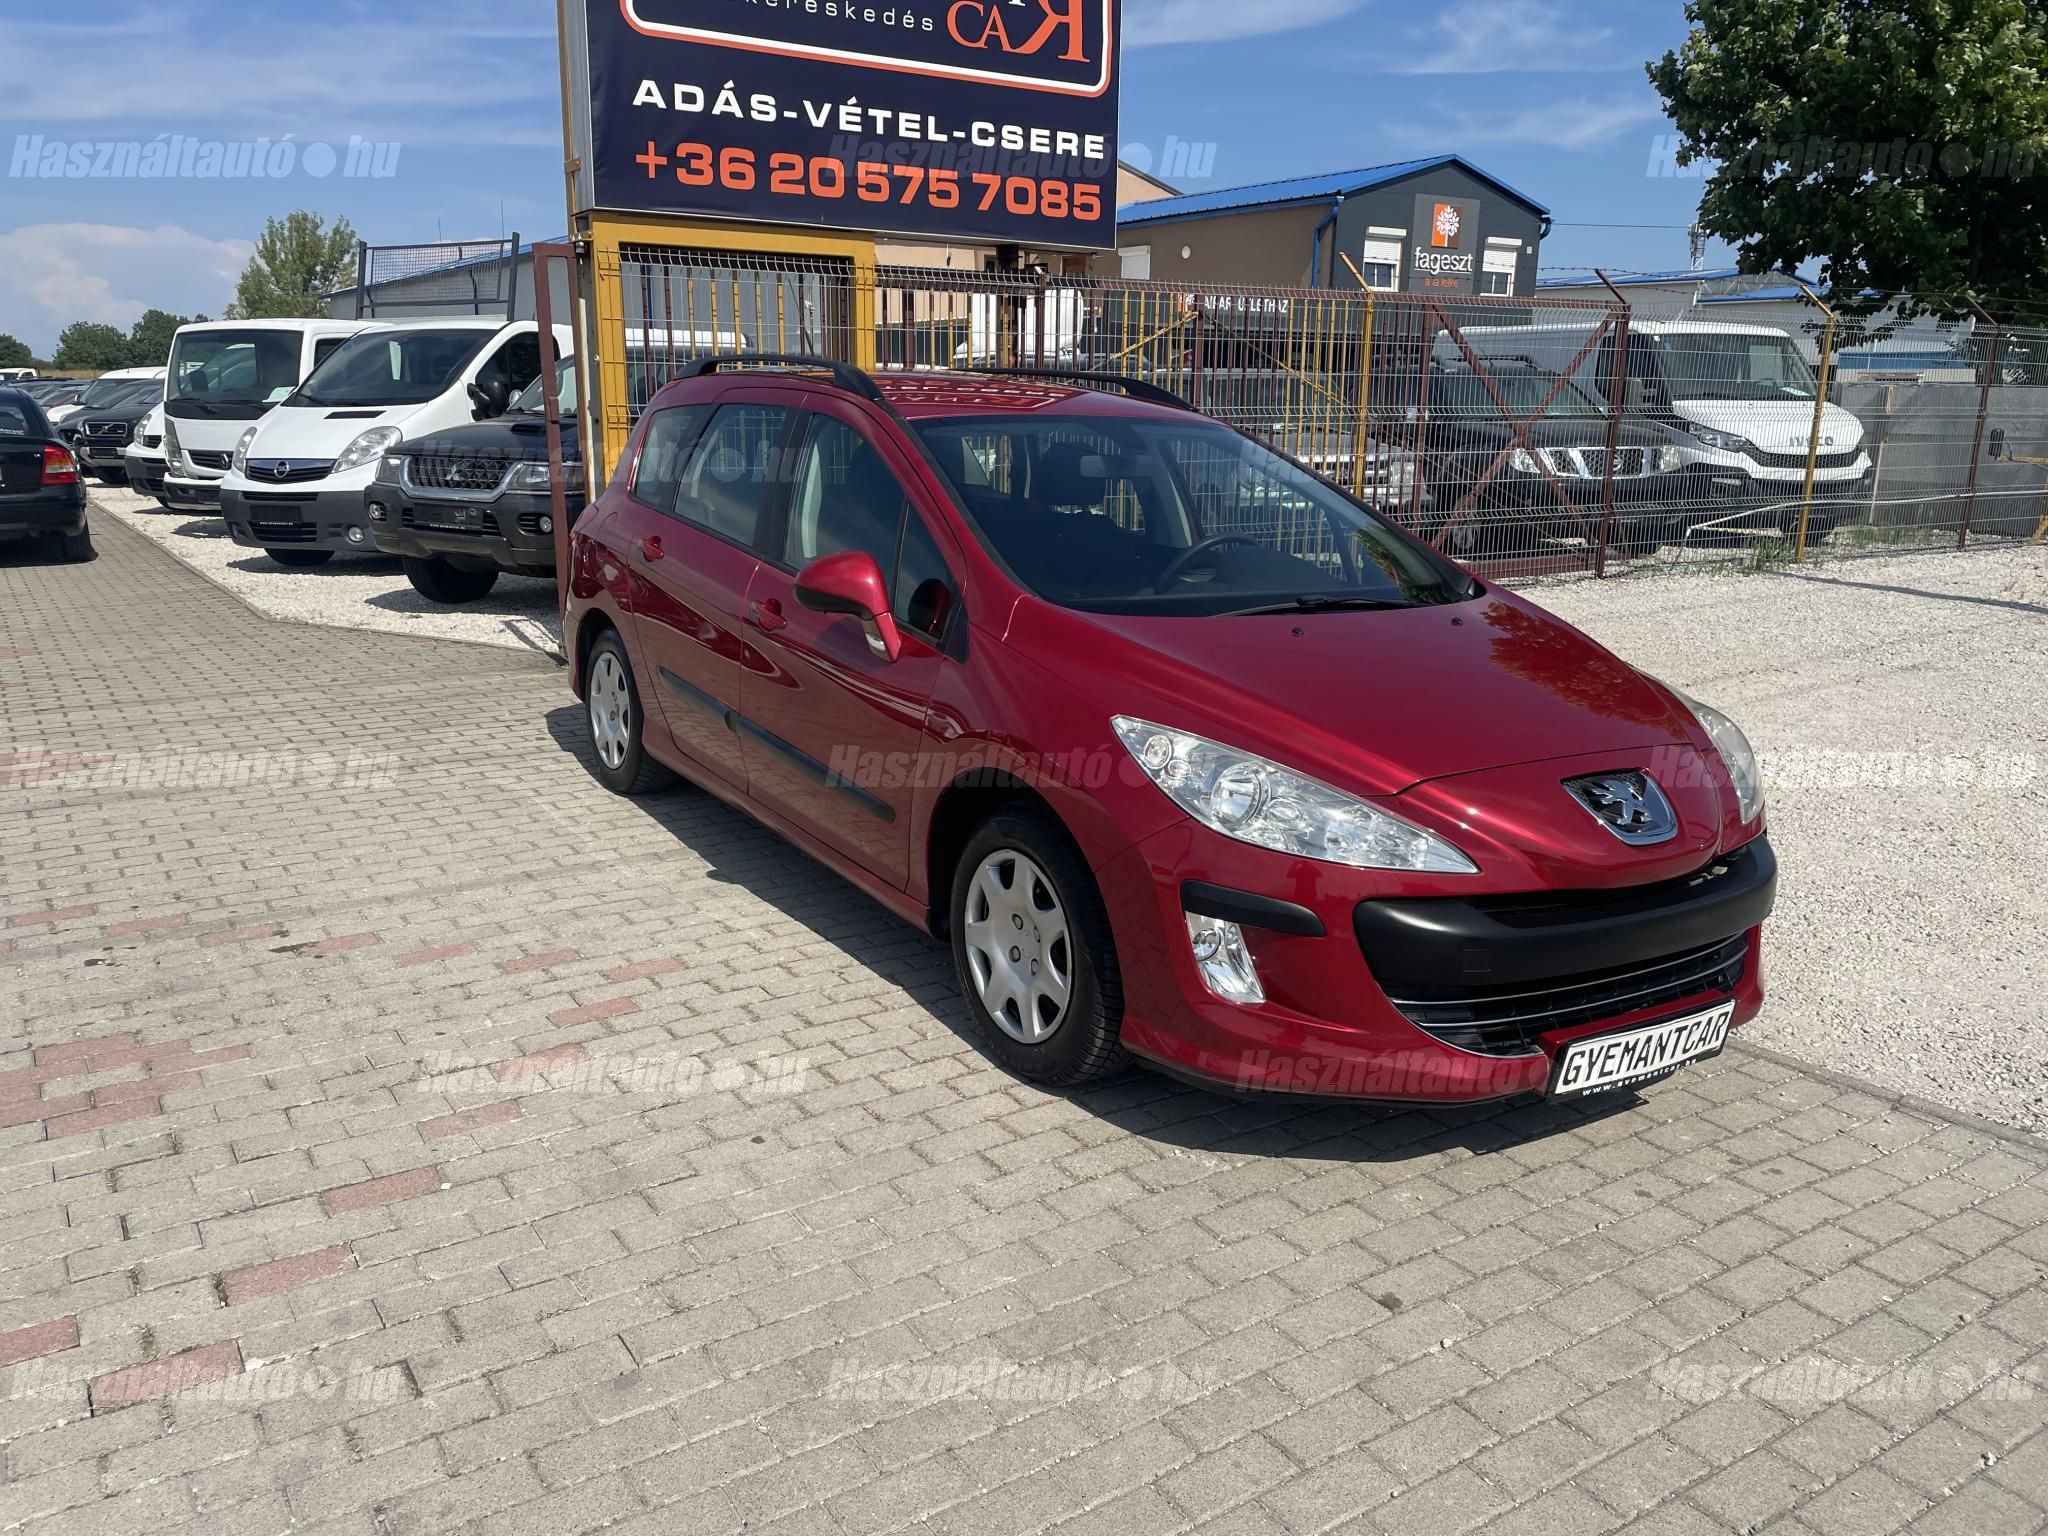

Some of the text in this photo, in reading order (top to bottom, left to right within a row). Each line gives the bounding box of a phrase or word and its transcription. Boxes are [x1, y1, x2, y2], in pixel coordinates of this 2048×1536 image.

[632, 79, 1104, 160] ADÁS-VÉTEL-CSERE
[635, 140, 1101, 221] +36 20 575 7085
[1414, 246, 1474, 275] fageszt
[1562, 1011, 1730, 1086] GYEMANTCAR
